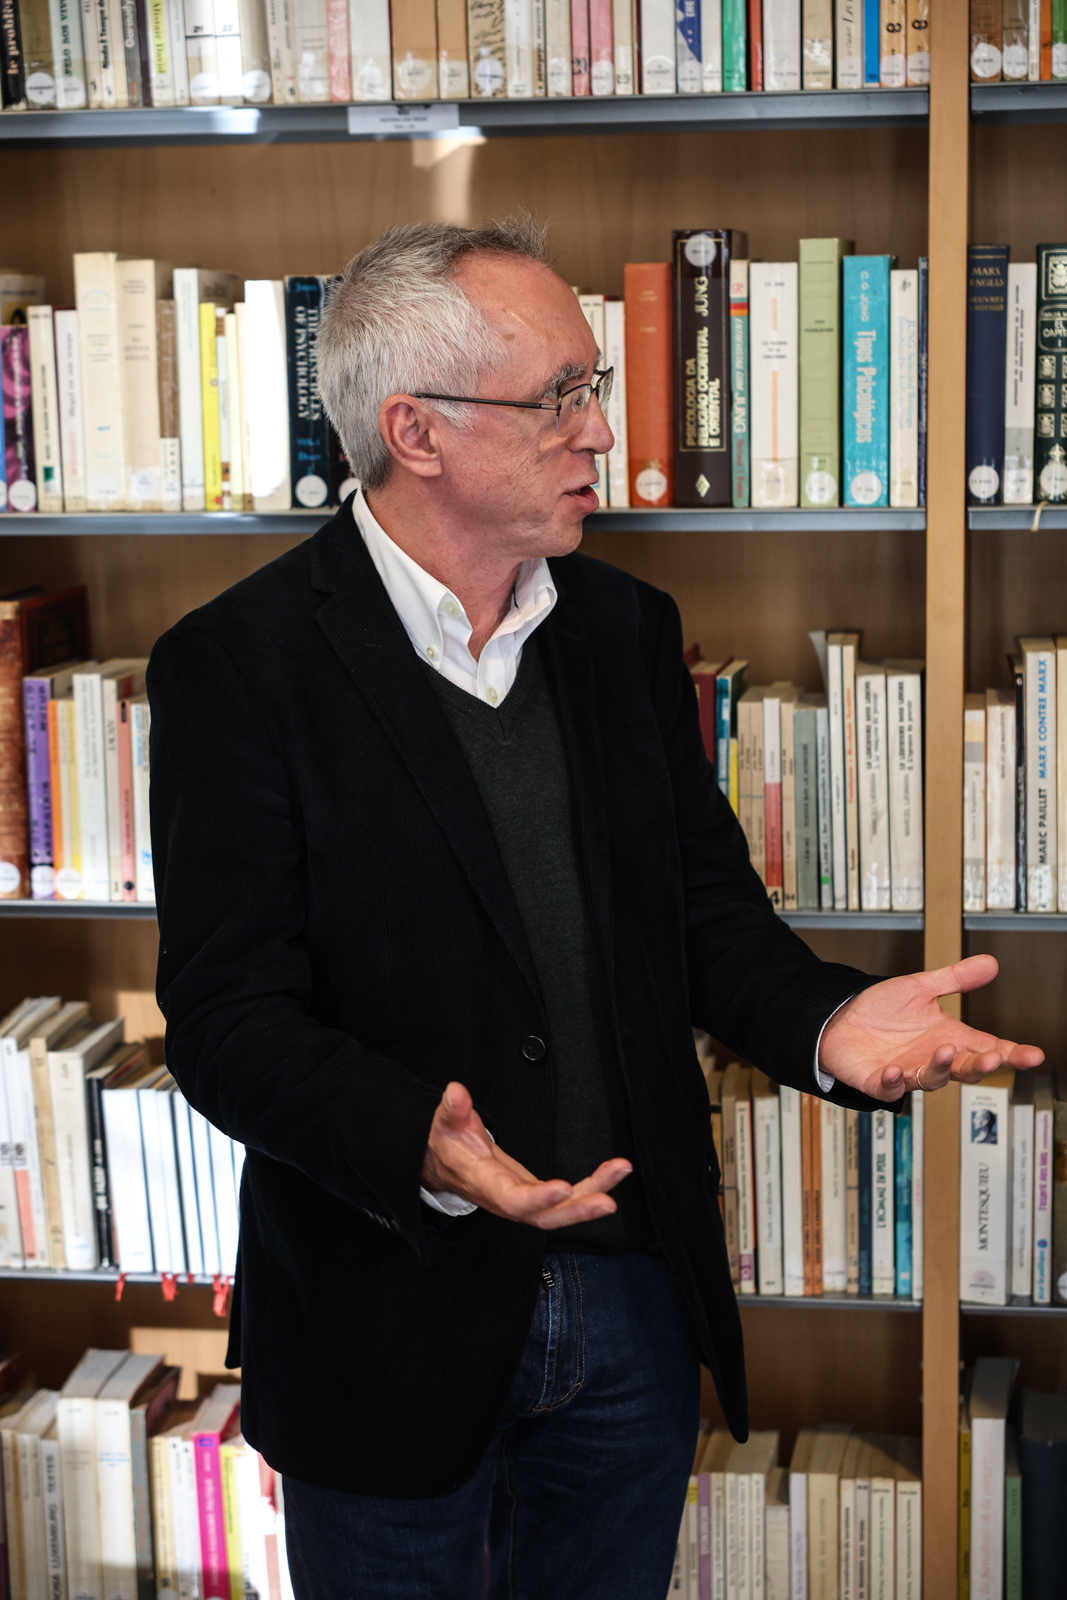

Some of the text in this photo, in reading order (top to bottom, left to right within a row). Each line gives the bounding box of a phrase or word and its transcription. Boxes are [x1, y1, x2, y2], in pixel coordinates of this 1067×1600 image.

[3, 0, 19, 55] problè
[63, 23, 71, 44] AOS
[972, 267, 1002, 276] MARX
[693, 275, 710, 318] JUNG
[861, 294, 870, 322] JUNG
[294, 306, 311, 421] OF PSYCHOLOGY
[733, 318, 747, 434] ENTREVISTAS COM JUNG
[906, 352, 916, 390] Selected
[685, 358, 697, 447] PSICOLOGIA DA
[695, 326, 710, 447] RELIGIÃO OCIDENTAL
[856, 328, 877, 444] Tipos Psicológicos
[707, 377, 720, 447] E ORIENTAL
[905, 391, 916, 428] Writings
[106, 719, 116, 752] LACAN
[1038, 658, 1048, 864] MARC PAILLET MARX CONTRE MARX
[876, 1109, 886, 1140] KONRA
[876, 1174, 886, 1184] EN
[876, 1187, 887, 1229] L'HOMME
[977, 1161, 991, 1253] MONTESQUIEU
[46, 1454, 57, 1494] TEXTES
[48, 1503, 61, 1569] LUXEMBURG
